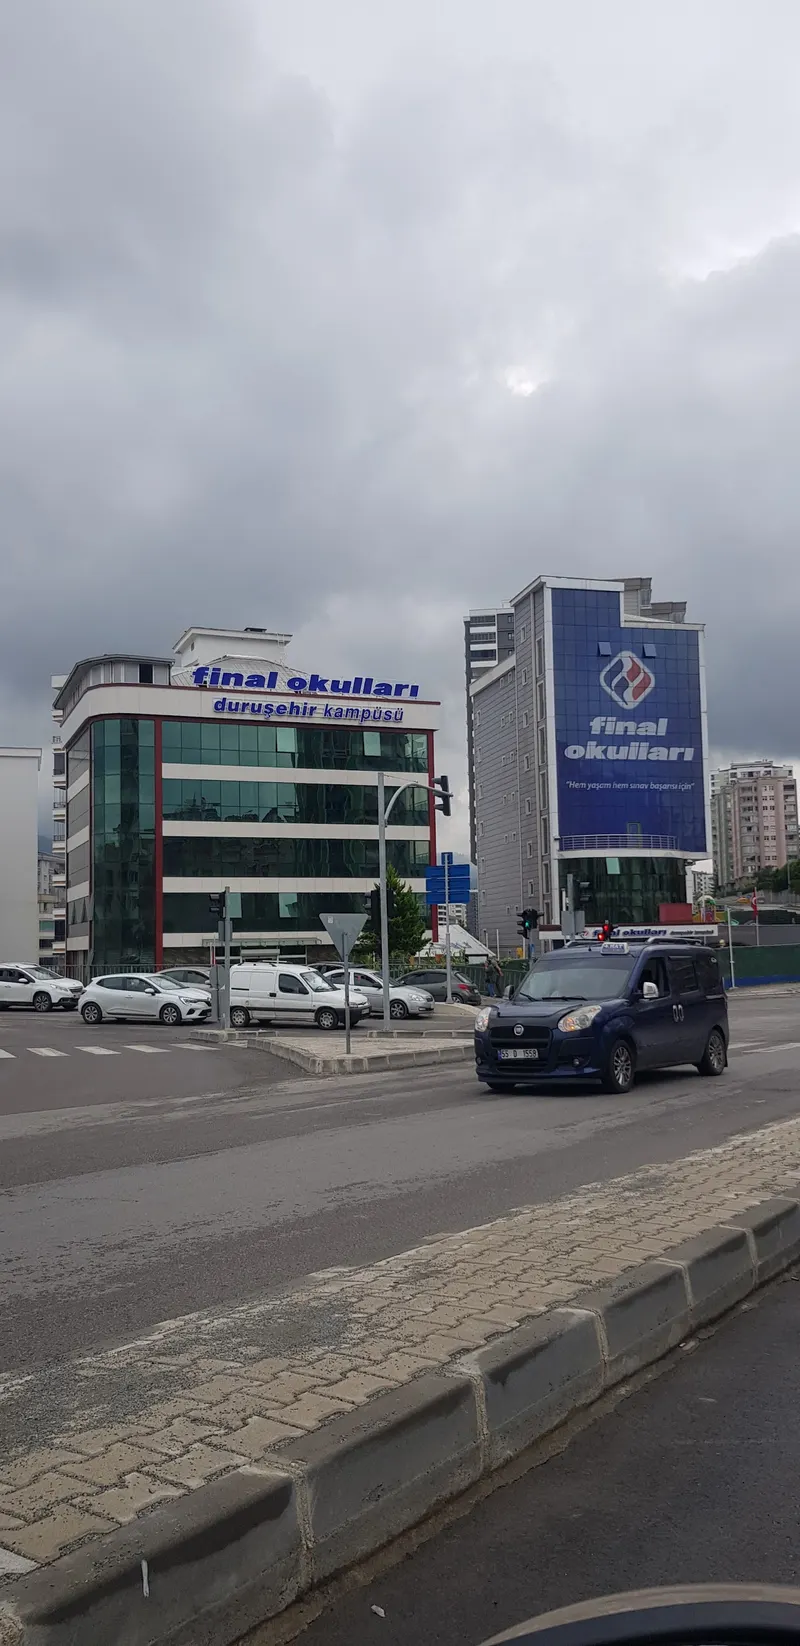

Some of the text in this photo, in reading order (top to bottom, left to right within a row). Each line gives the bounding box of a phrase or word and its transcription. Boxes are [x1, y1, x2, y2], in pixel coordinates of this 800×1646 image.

[192, 667, 419, 697] final okulları
[213, 697, 405, 724] duruşehir kampüsü
[589, 716, 668, 736] final
[564, 741, 695, 761] okulları
[587, 782, 612, 791] yaşam
[612, 781, 629, 789] hem
